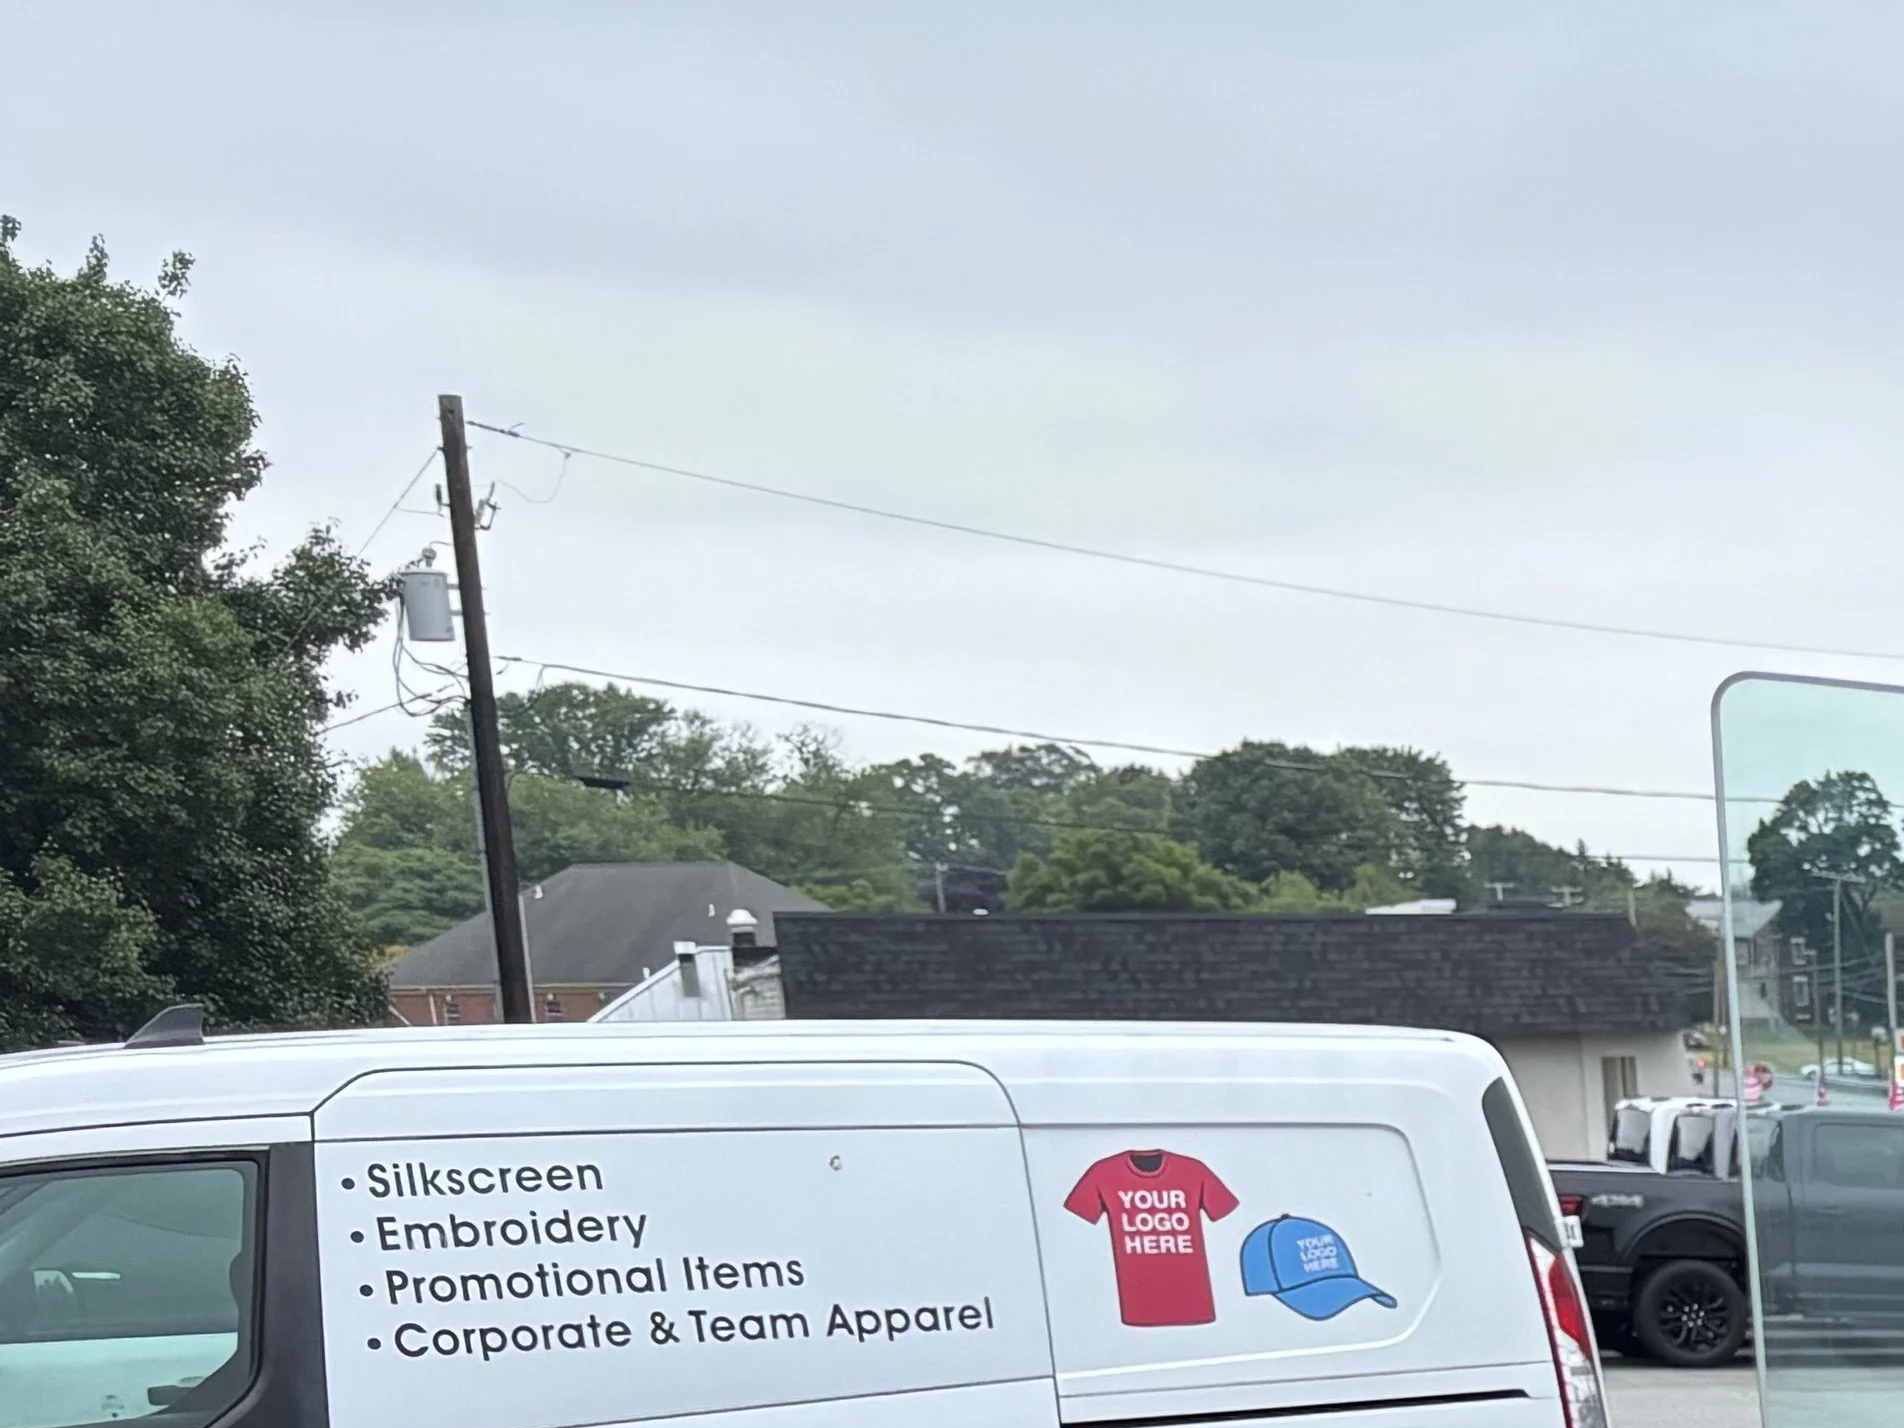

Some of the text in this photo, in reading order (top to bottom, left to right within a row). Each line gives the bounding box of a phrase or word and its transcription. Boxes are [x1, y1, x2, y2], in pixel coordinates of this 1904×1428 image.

[367, 1162, 604, 1198] Silkscreen
[1117, 1189, 1186, 1210] YOUR
[376, 1209, 647, 1251] Embroidery
[1121, 1212, 1190, 1232] LOGO
[1124, 1235, 1194, 1254] HERE
[1300, 1246, 1337, 1262] LOGO
[385, 1256, 804, 1305] Promotional Items
[394, 1296, 994, 1362] Corporate & Team Apparel
